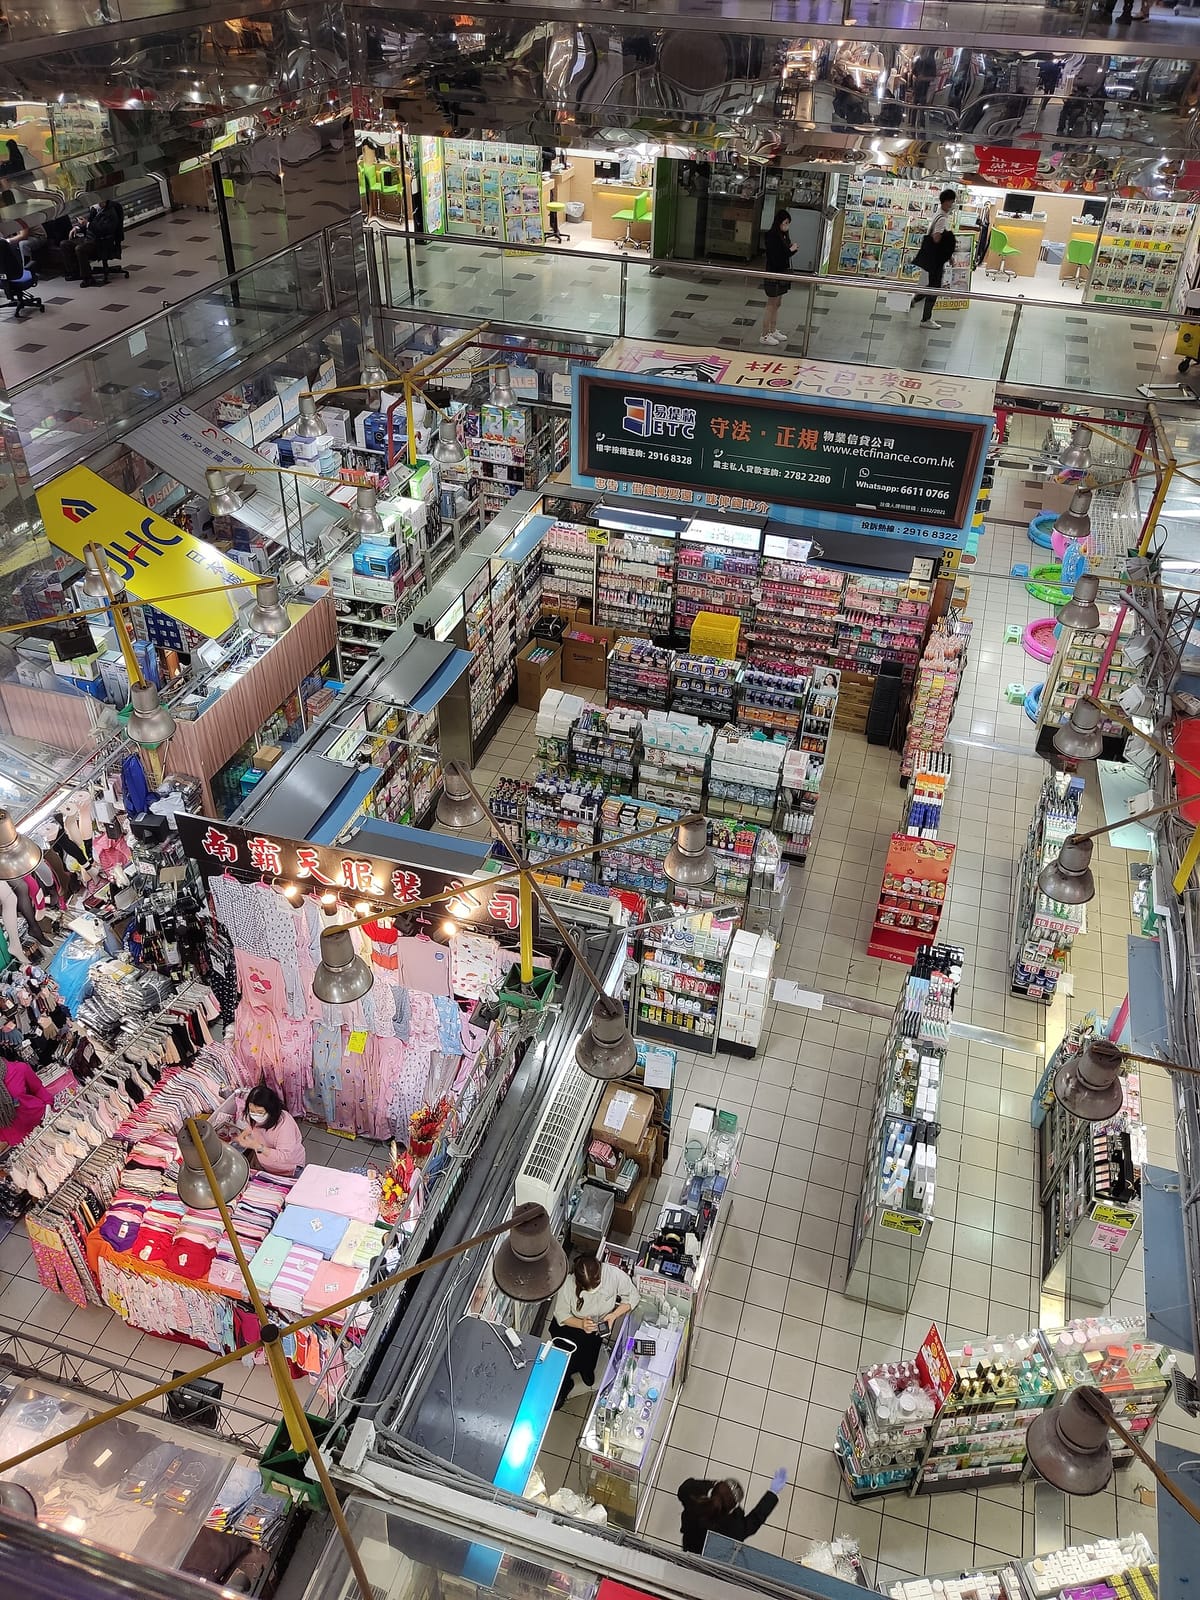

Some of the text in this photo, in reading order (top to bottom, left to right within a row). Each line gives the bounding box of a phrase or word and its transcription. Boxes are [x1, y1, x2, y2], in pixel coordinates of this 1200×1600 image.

[168, 407, 191, 425] JHC
[652, 419, 695, 440] ETC
[823, 430, 895, 450] 物業信貸公司
[647, 450, 669, 462] 2916
[670, 454, 693, 466] 8328
[822, 443, 956, 469] www.etcfinance.com.hk
[783, 469, 807, 482] 2782
[807, 472, 831, 485] 2280
[855, 480, 950, 500] Whatsapp: 6611 0766
[902, 527, 929, 538] 2916
[931, 530, 959, 542] 8322
